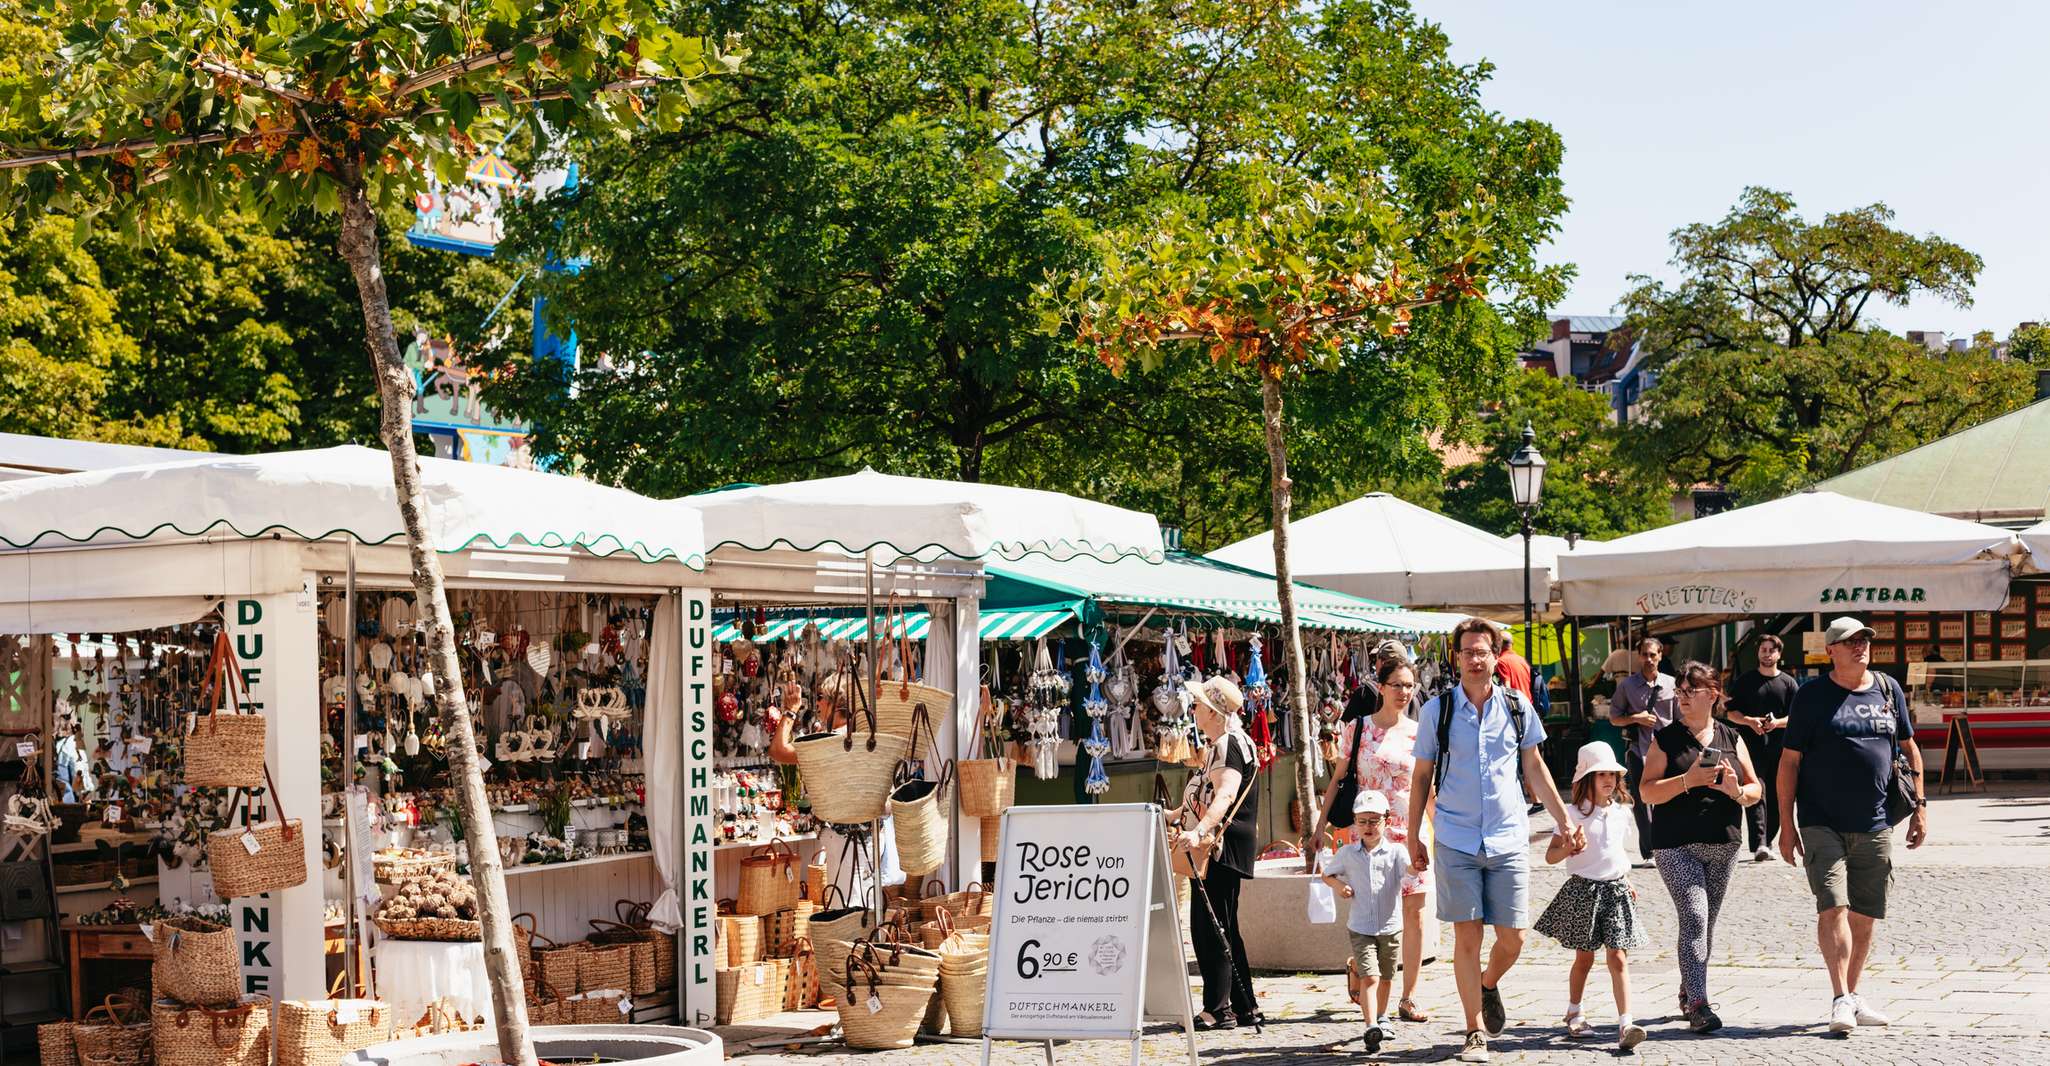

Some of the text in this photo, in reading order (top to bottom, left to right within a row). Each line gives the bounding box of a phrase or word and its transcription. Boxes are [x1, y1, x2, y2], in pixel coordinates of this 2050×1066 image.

[1820, 587, 1926, 603] SAFTBAR
[690, 600, 708, 984] DUFTSCHMANKERL
[1016, 842, 1124, 872] Rose von
[1014, 873, 1129, 904] Jericho
[1011, 915, 1025, 924] Die
[1027, 915, 1056, 924] Pflanze
[1063, 915, 1075, 923] die
[1076, 915, 1104, 924] niemals
[1105, 914, 1128, 923] stirbt!
[1009, 1002, 1116, 1011] DUFTSCHMANKERL
